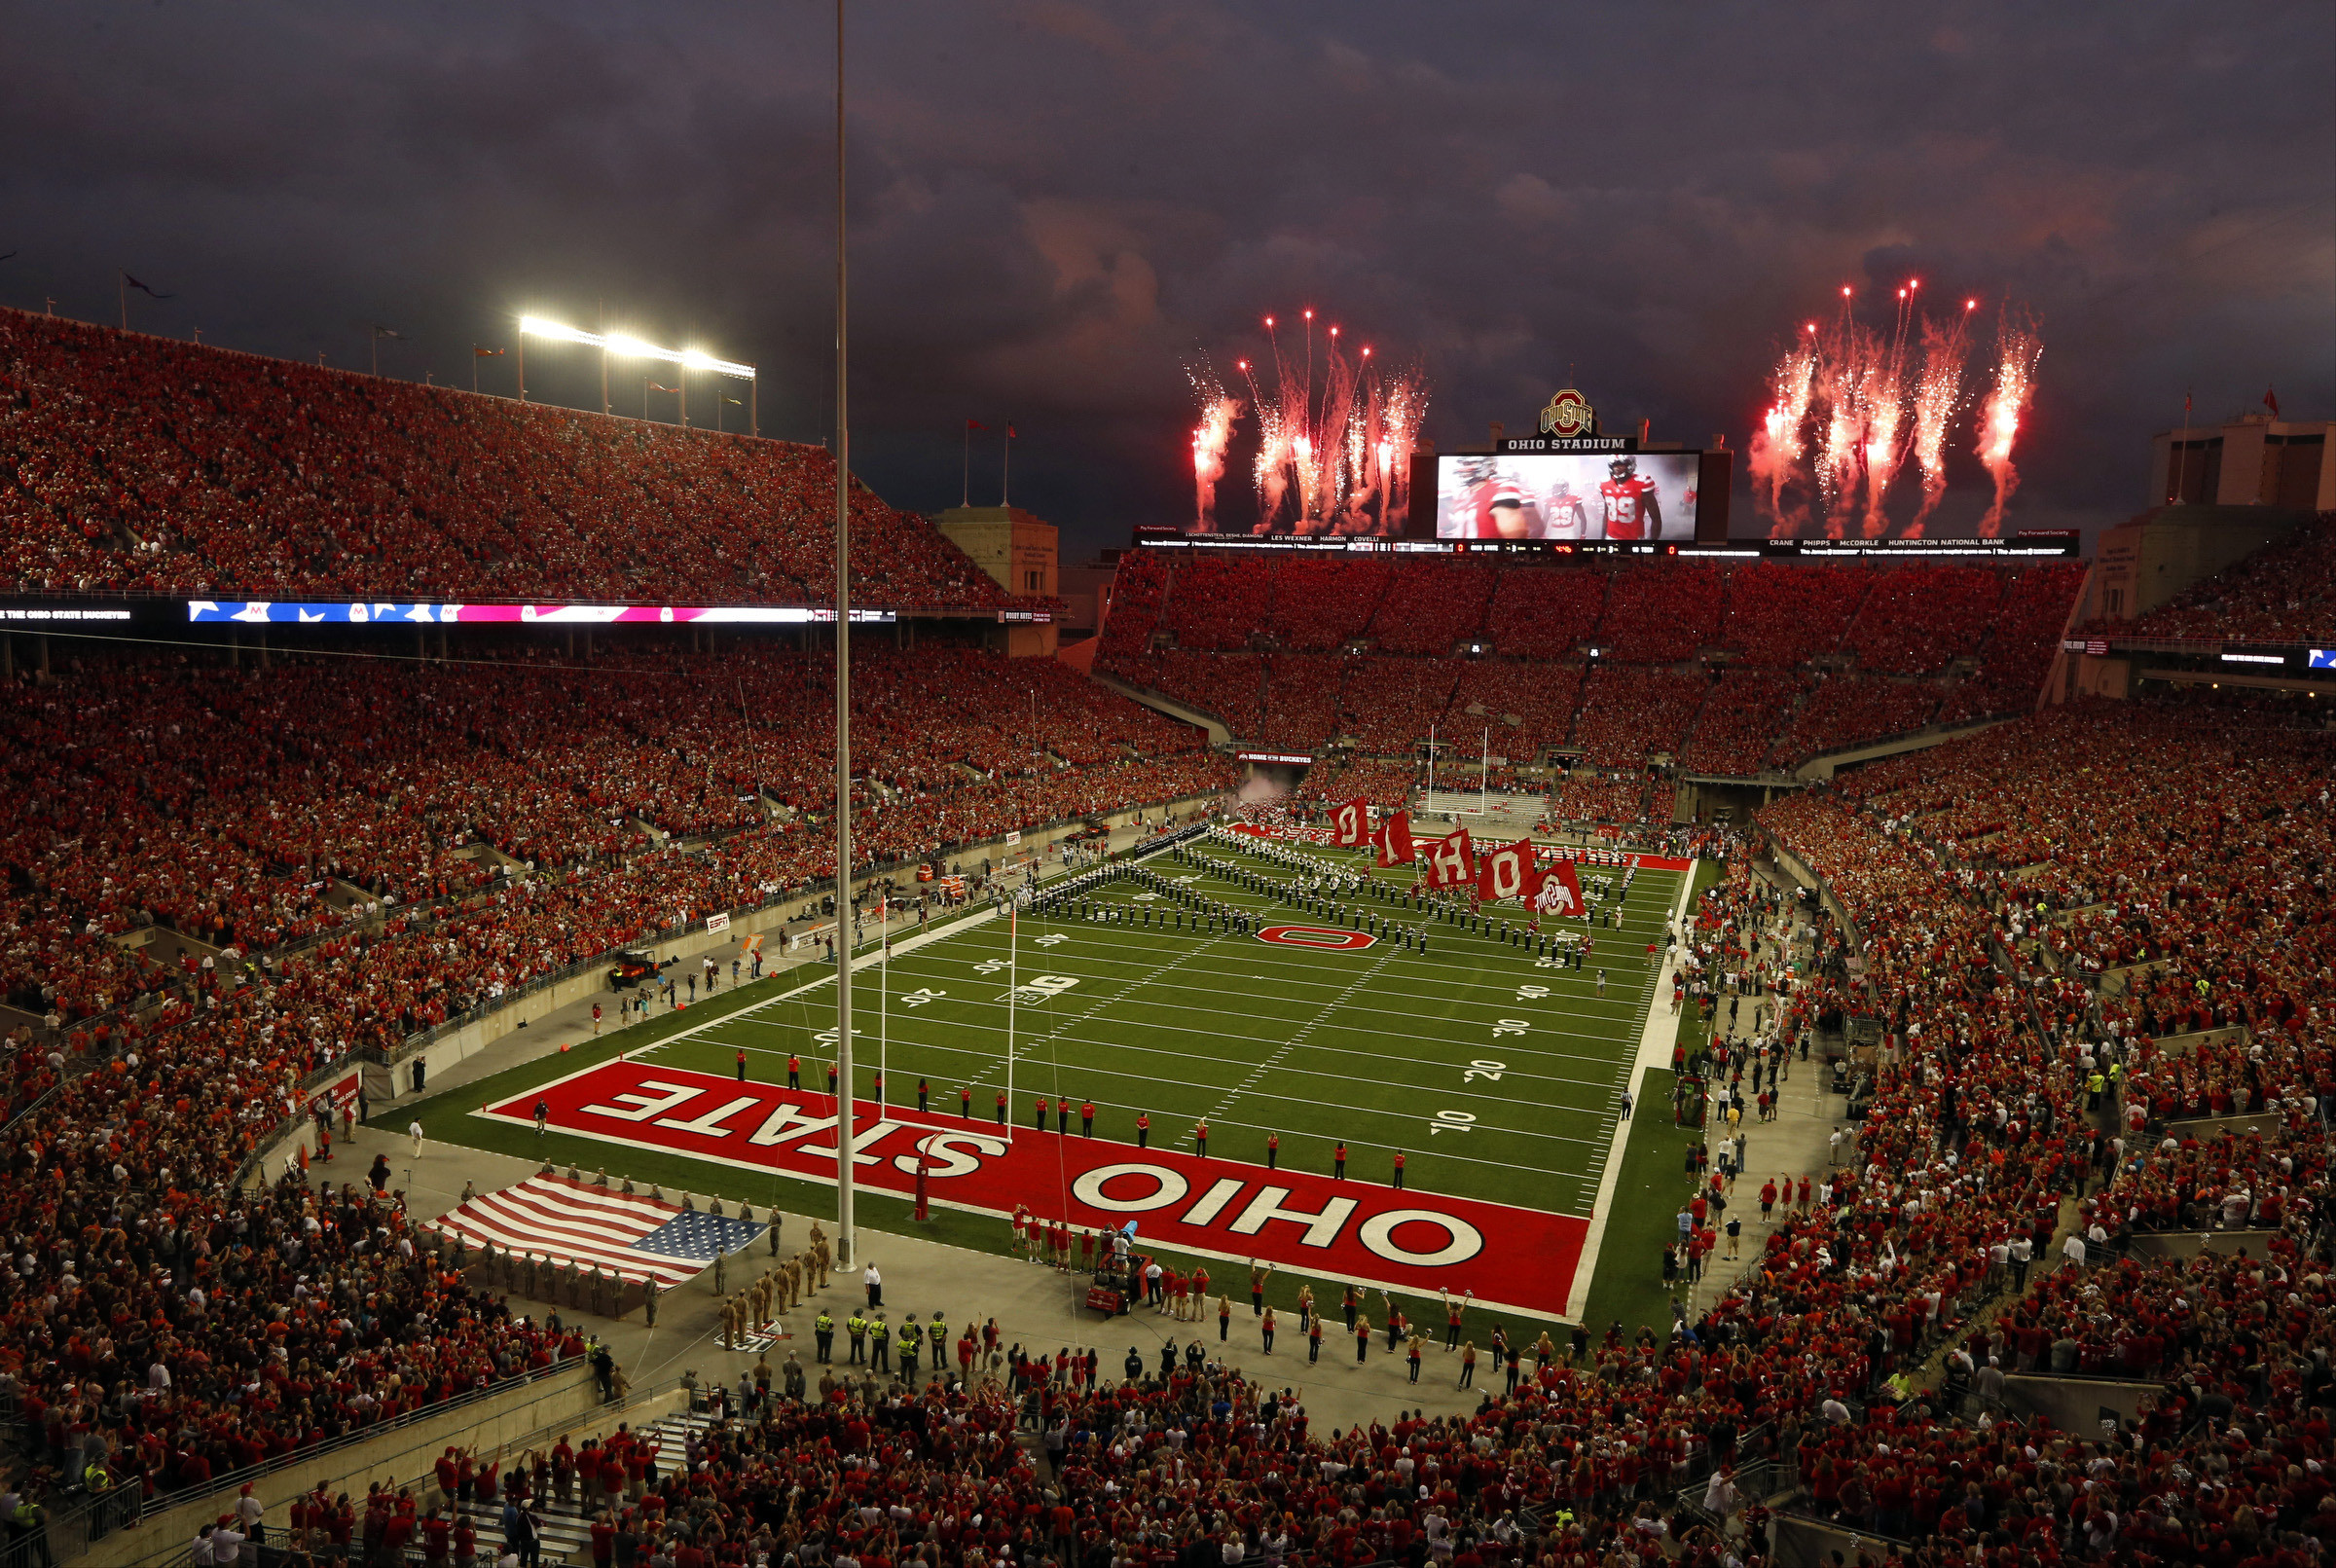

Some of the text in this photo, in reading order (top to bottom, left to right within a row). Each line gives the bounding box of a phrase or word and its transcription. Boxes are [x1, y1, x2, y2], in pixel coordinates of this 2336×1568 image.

[1508, 439, 1625, 450] OHIO STADIUM
[1668, 546, 1675, 555] 0
[6, 610, 26, 619] THE
[27, 610, 51, 619] OHIO
[53, 610, 81, 619] STATE
[1338, 805, 1357, 844] O
[1434, 835, 1467, 883] H
[1491, 850, 1520, 898] O
[709, 916, 728, 930] ESPN
[1534, 956, 1566, 968] 50
[900, 988, 947, 1004] 20
[1516, 985, 1551, 1000] 40
[1492, 1019, 1530, 1036] 30
[1464, 1059, 1507, 1081] 20
[1430, 1110, 1477, 1132] 10
[578, 1079, 1485, 1265] OHIO STATE
[1836, 1375, 1843, 1387] 5
[1885, 1411, 1891, 1424] 2
